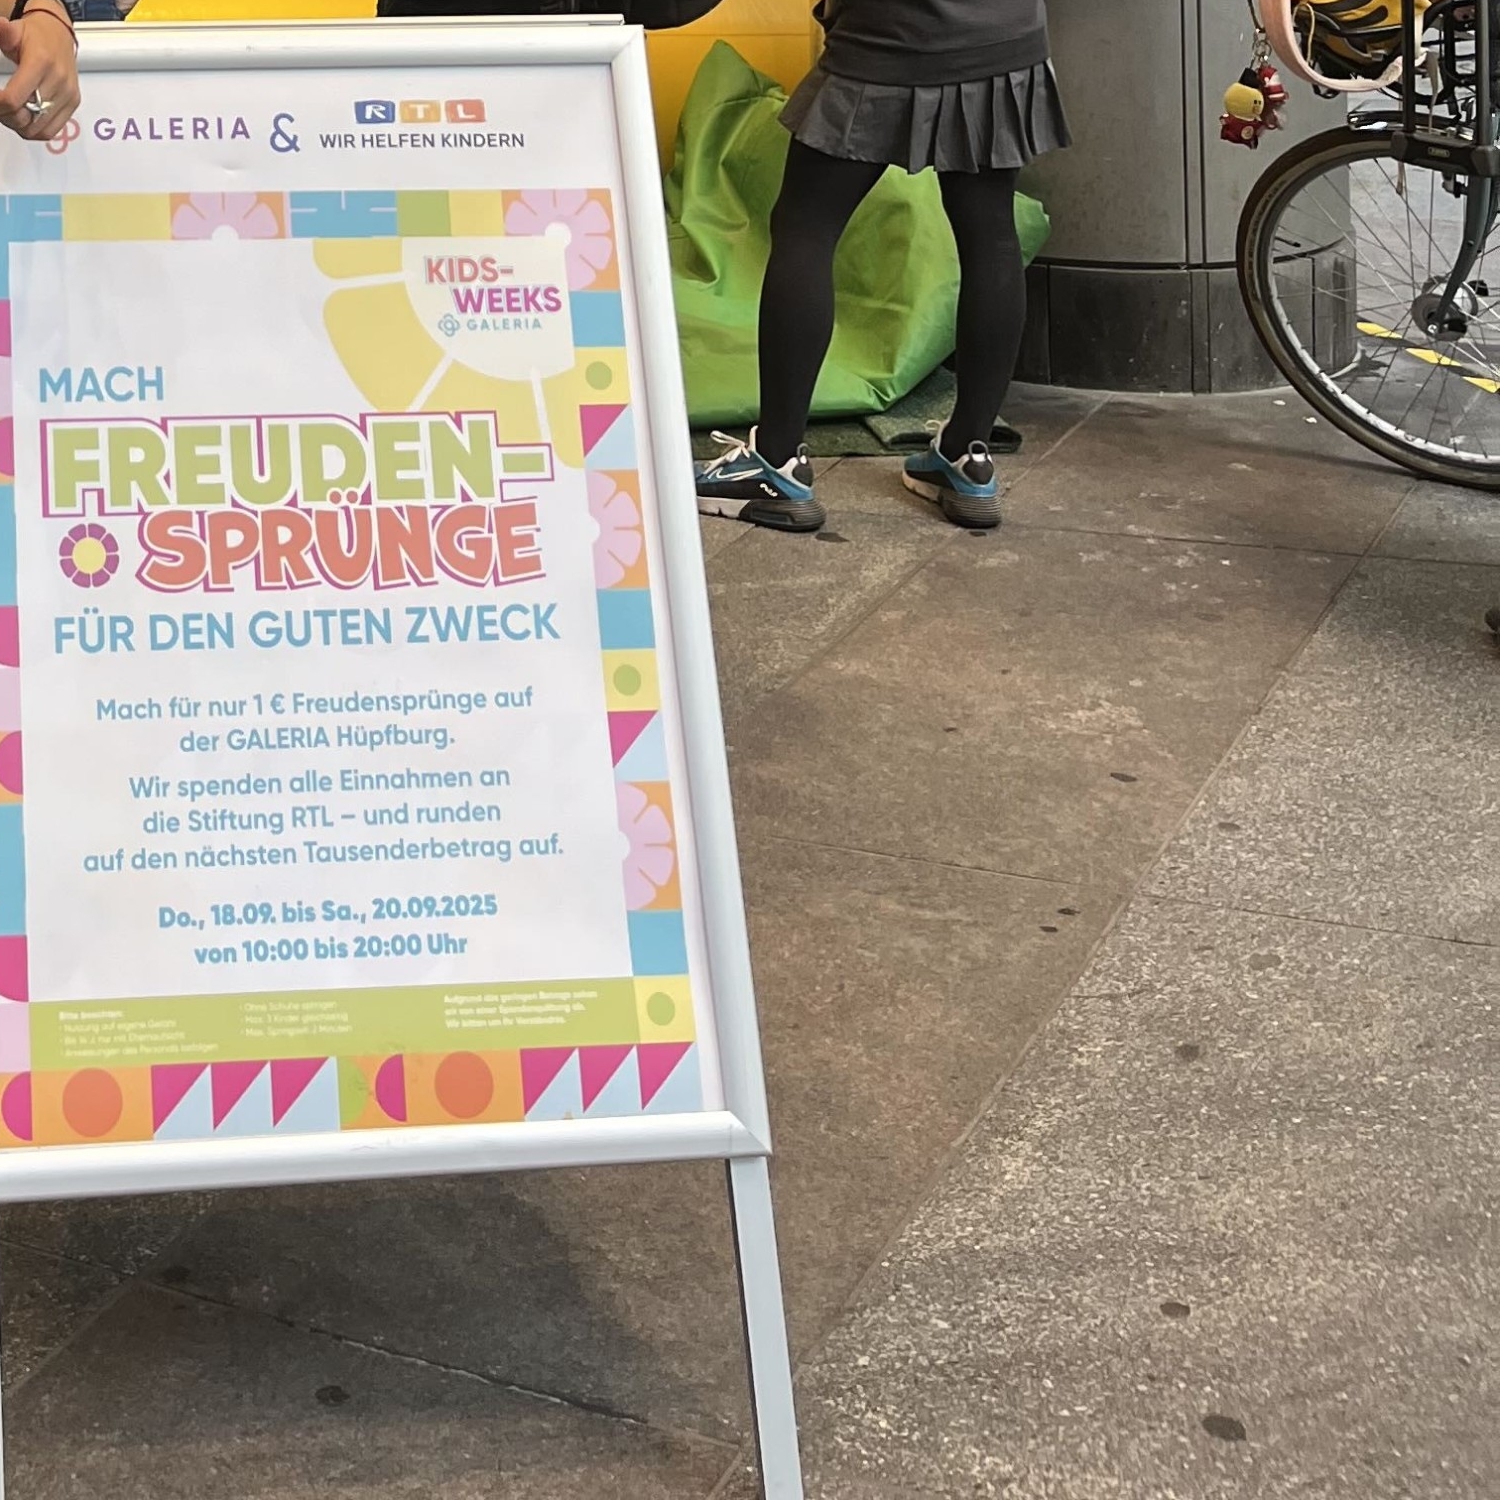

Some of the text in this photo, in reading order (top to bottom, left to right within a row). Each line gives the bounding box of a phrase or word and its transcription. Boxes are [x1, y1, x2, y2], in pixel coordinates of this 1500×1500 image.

[360, 102, 479, 122] RTL
[94, 113, 300, 152] GALERIA &
[320, 134, 524, 148] WIR HELFEN KINDERN
[425, 256, 514, 286] KIDS-
[452, 284, 562, 316] WEEKS
[467, 318, 541, 330] GALERIA
[39, 366, 163, 403] MACH
[42, 411, 553, 517] FREUDEN-
[136, 487, 546, 593] SPRÜNGE
[55, 603, 560, 653] FÜR DEN GUTEN ZWECK
[97, 686, 532, 720] Mach für nur 1 € Freudensprünge auf
[180, 724, 455, 752] der GALERIA Hüpfburg.
[129, 768, 510, 802] Wir spenden alle Einnahmen an
[143, 811, 180, 833] die
[189, 809, 284, 835] Stiftung
[292, 806, 334, 828] RTL
[364, 803, 409, 825] und
[417, 801, 500, 823] runden
[84, 833, 563, 871] auf den nächsten Tausenderbetrag auf.
[159, 894, 497, 930] Do., 18.09. bis Sa., 20.09.2025
[194, 933, 467, 963] von 10:00 bis 20:00 Uhr
